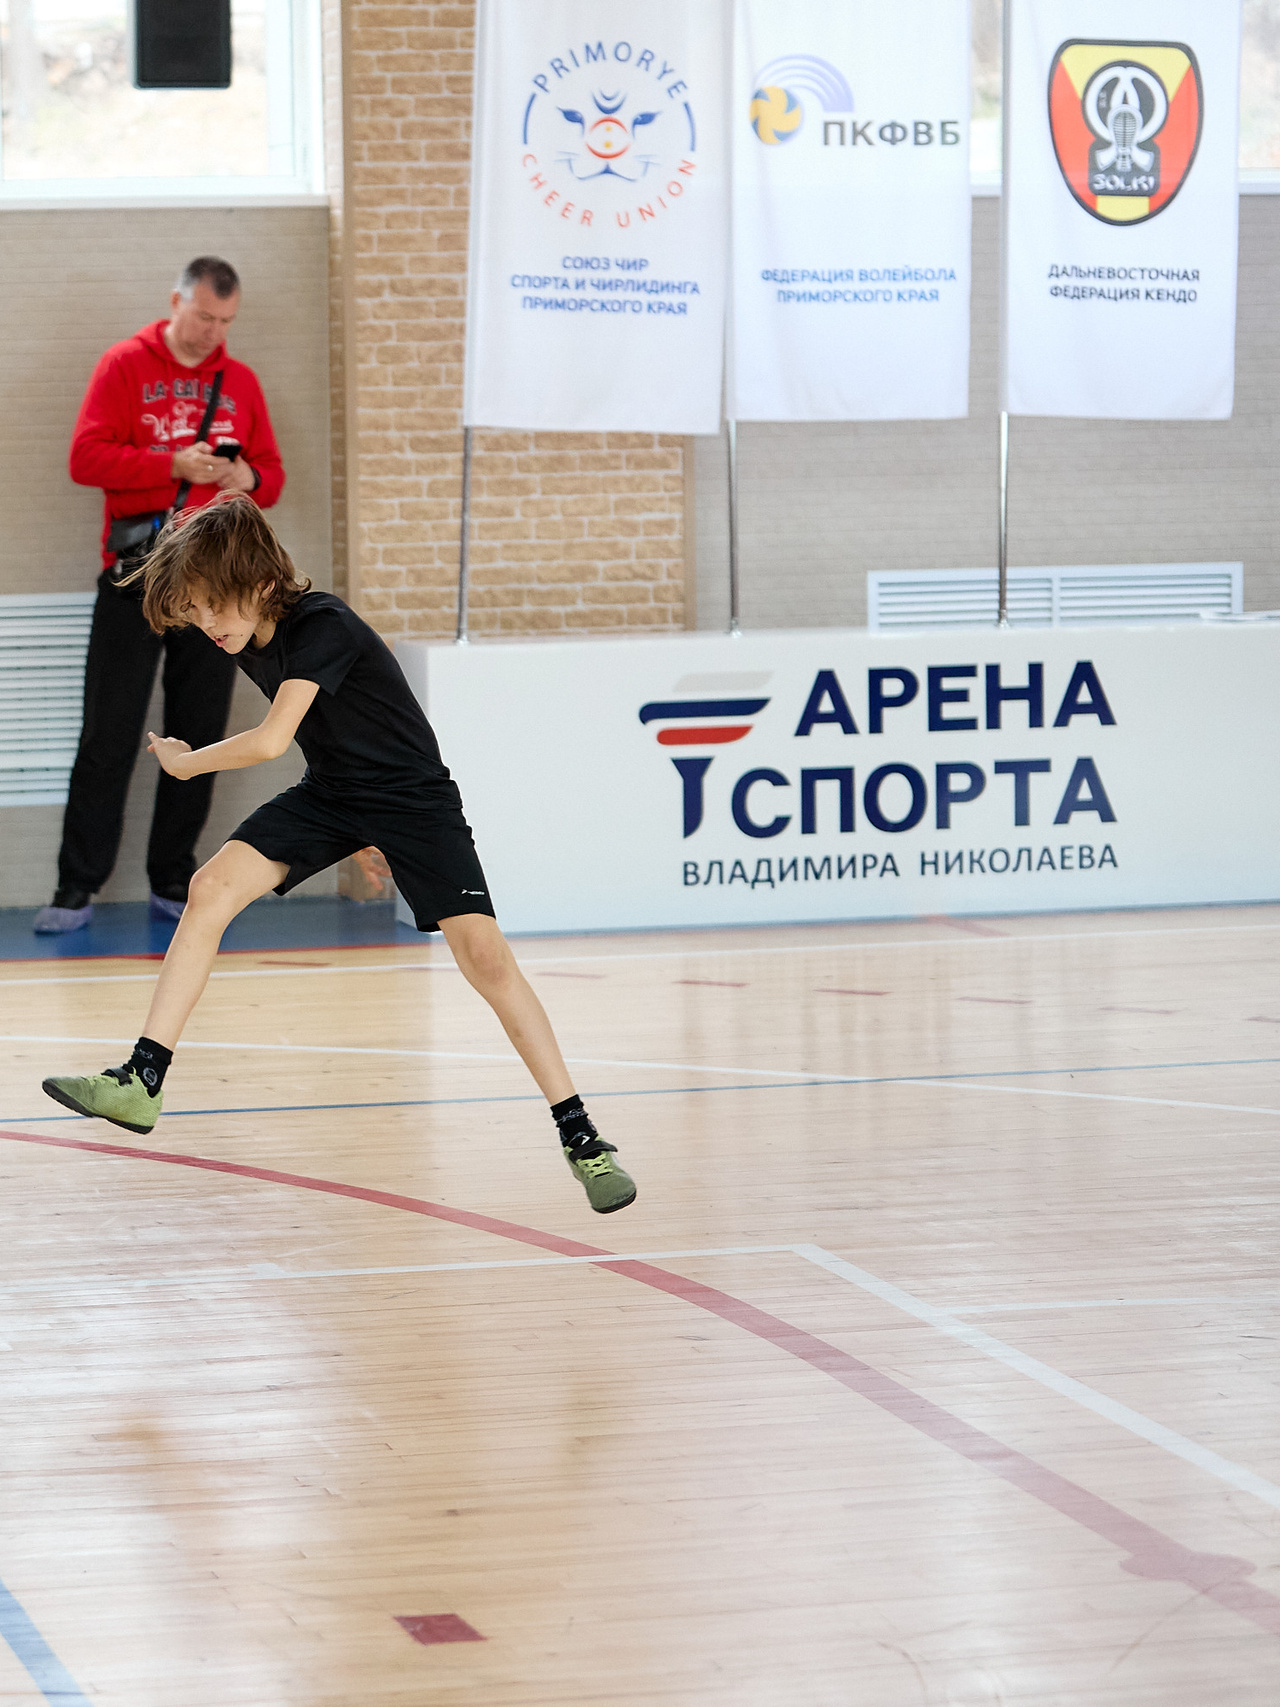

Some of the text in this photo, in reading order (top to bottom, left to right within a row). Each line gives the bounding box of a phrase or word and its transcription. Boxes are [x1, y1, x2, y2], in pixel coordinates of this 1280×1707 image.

[532, 41, 688, 99] PRIMORYE
[823, 120, 960, 146] ПКФВБ
[522, 153, 697, 228] CHEER UNION
[561, 256, 649, 271] СОЮЗ ЧИР
[1048, 264, 1200, 281] ДАЛЬНЕВОСТОЧНАЯ
[511, 274, 700, 295] СПОРТА И ЧИРЛИДИНГА
[761, 265, 957, 284] ФЕДЕРАЦИЯ ВОЛЕЙБОЛА
[777, 288, 939, 303] ПРИМОРСКОГО КРАЯ
[1050, 285, 1197, 303] ФЕДЕРАЦИЯ КЕНДО
[522, 296, 688, 315] ПРИМОРСКОГО КРАЯ
[794, 660, 1117, 737] АРЕНА
[731, 757, 1118, 839] СПОРТА
[683, 844, 1119, 889] ВЛАДИМИРА НИКОЛАЕВА
